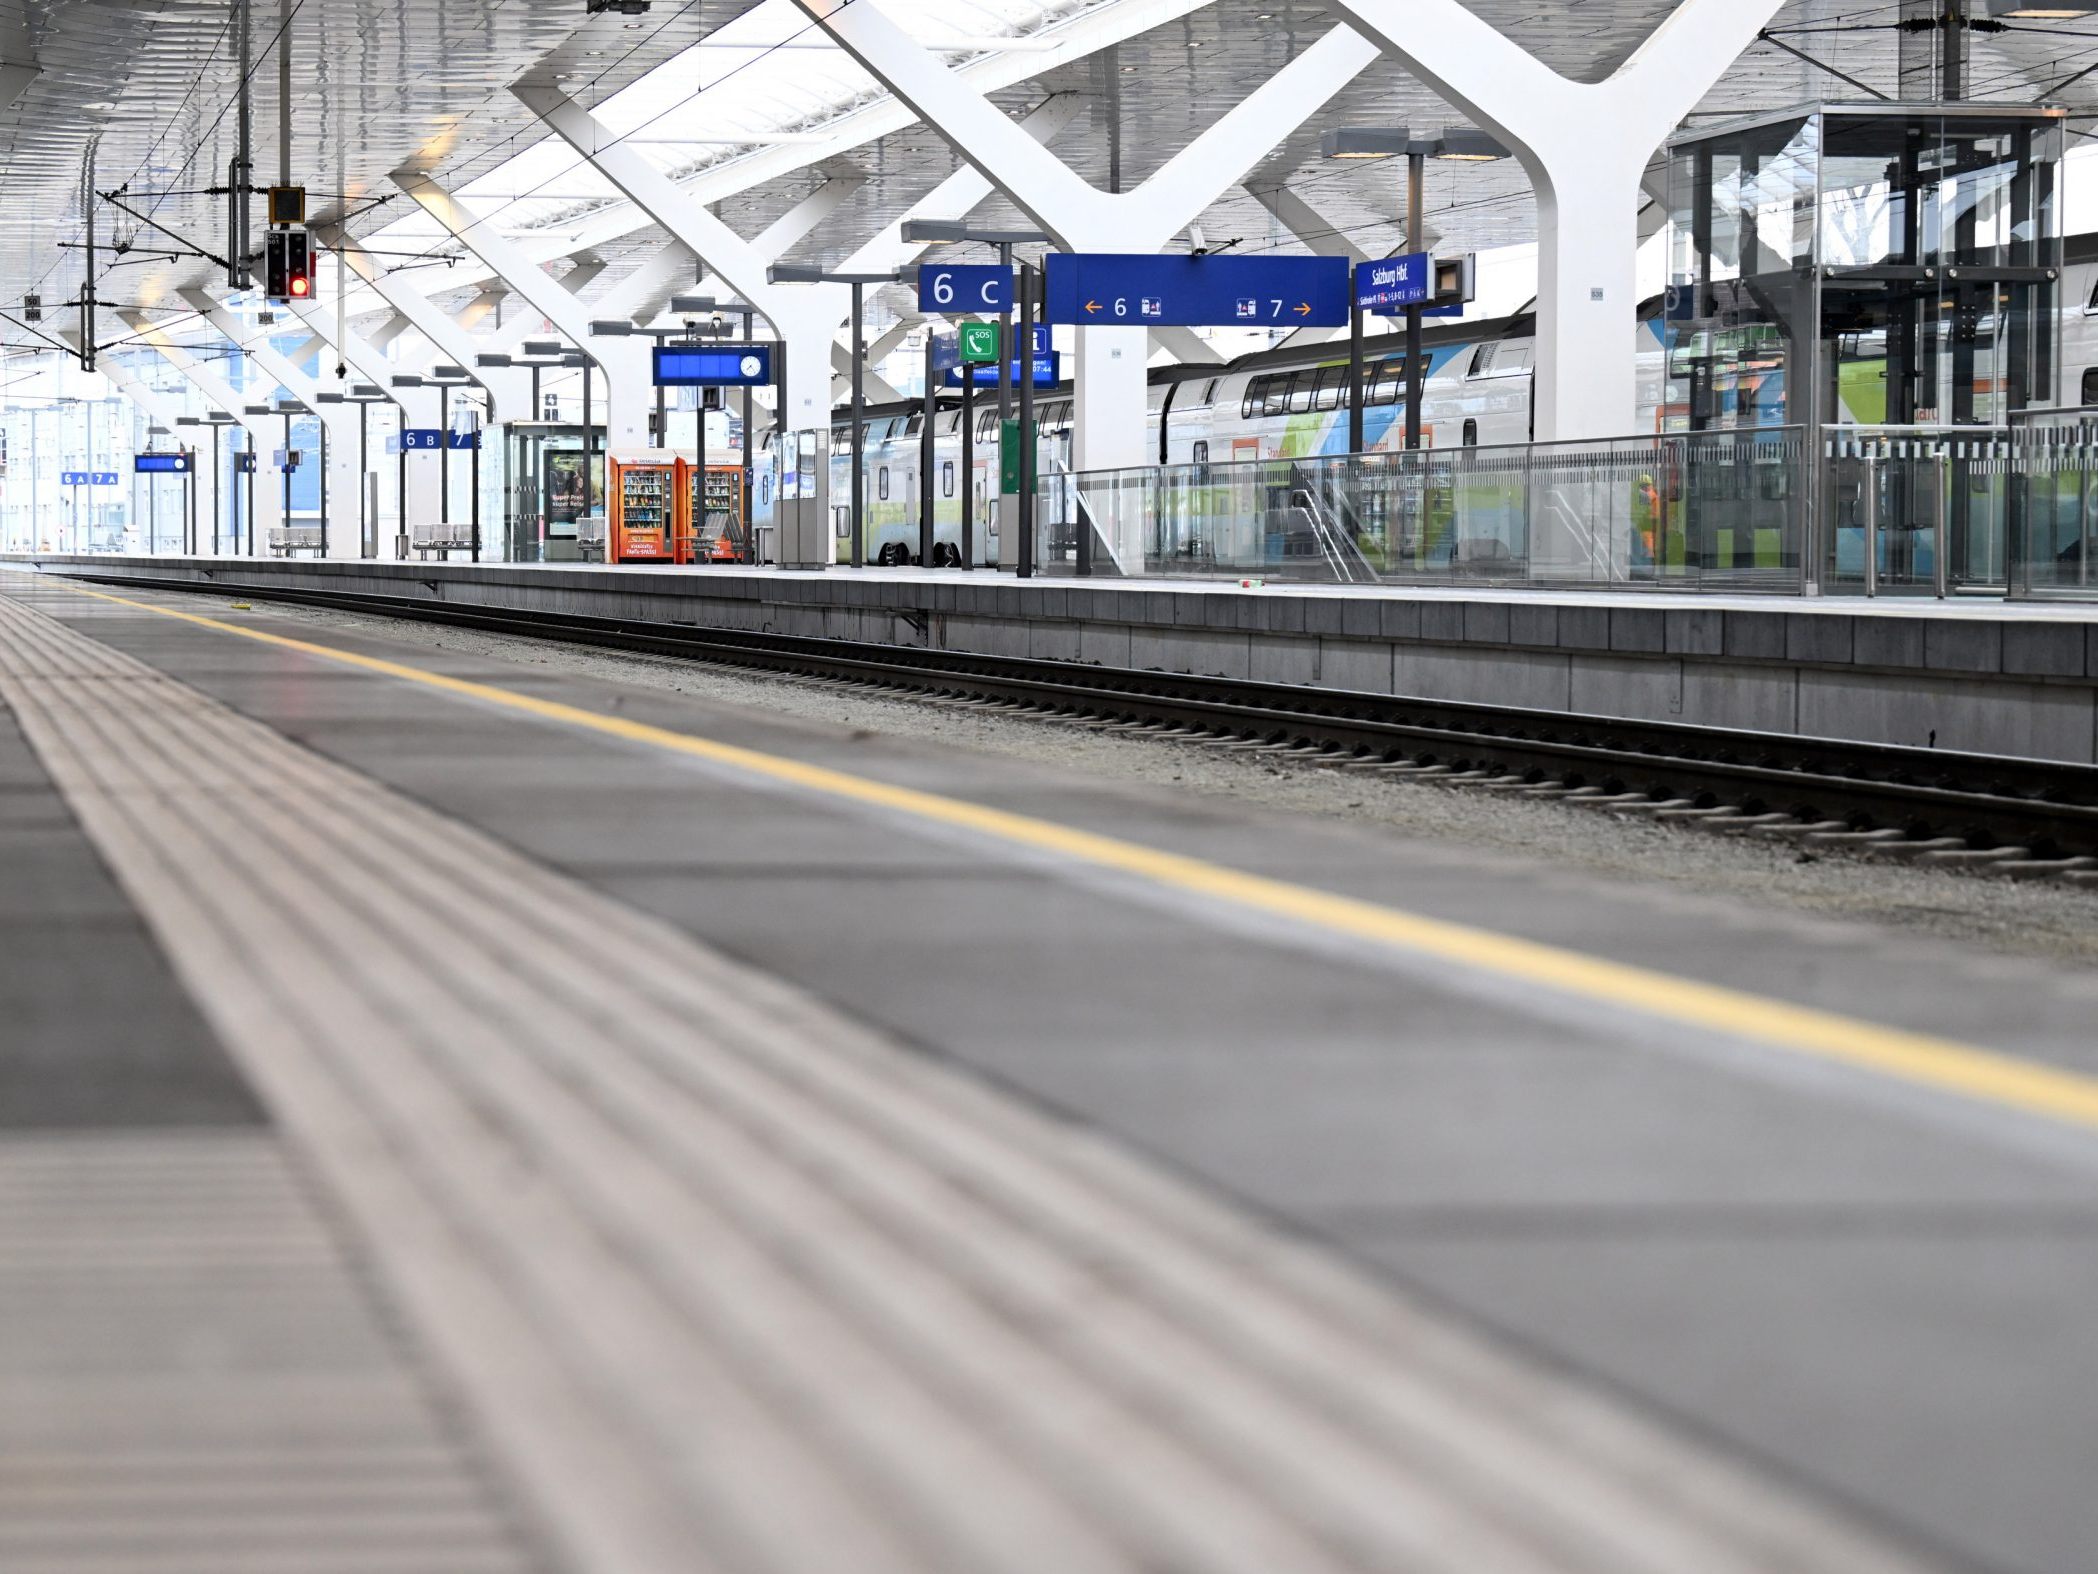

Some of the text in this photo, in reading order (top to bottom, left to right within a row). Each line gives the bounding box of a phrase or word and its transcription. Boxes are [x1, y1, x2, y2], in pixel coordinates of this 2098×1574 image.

[1372, 267, 1395, 287] Salzburg
[933, 273, 998, 304] 6 C
[1114, 298, 1127, 316] 6
[1270, 299, 1283, 318] 7
[26, 311, 40, 319] 200
[975, 331, 990, 339] SOS
[406, 432, 434, 446] 6 B
[64, 474, 71, 483] 6
[96, 474, 102, 483] 7
